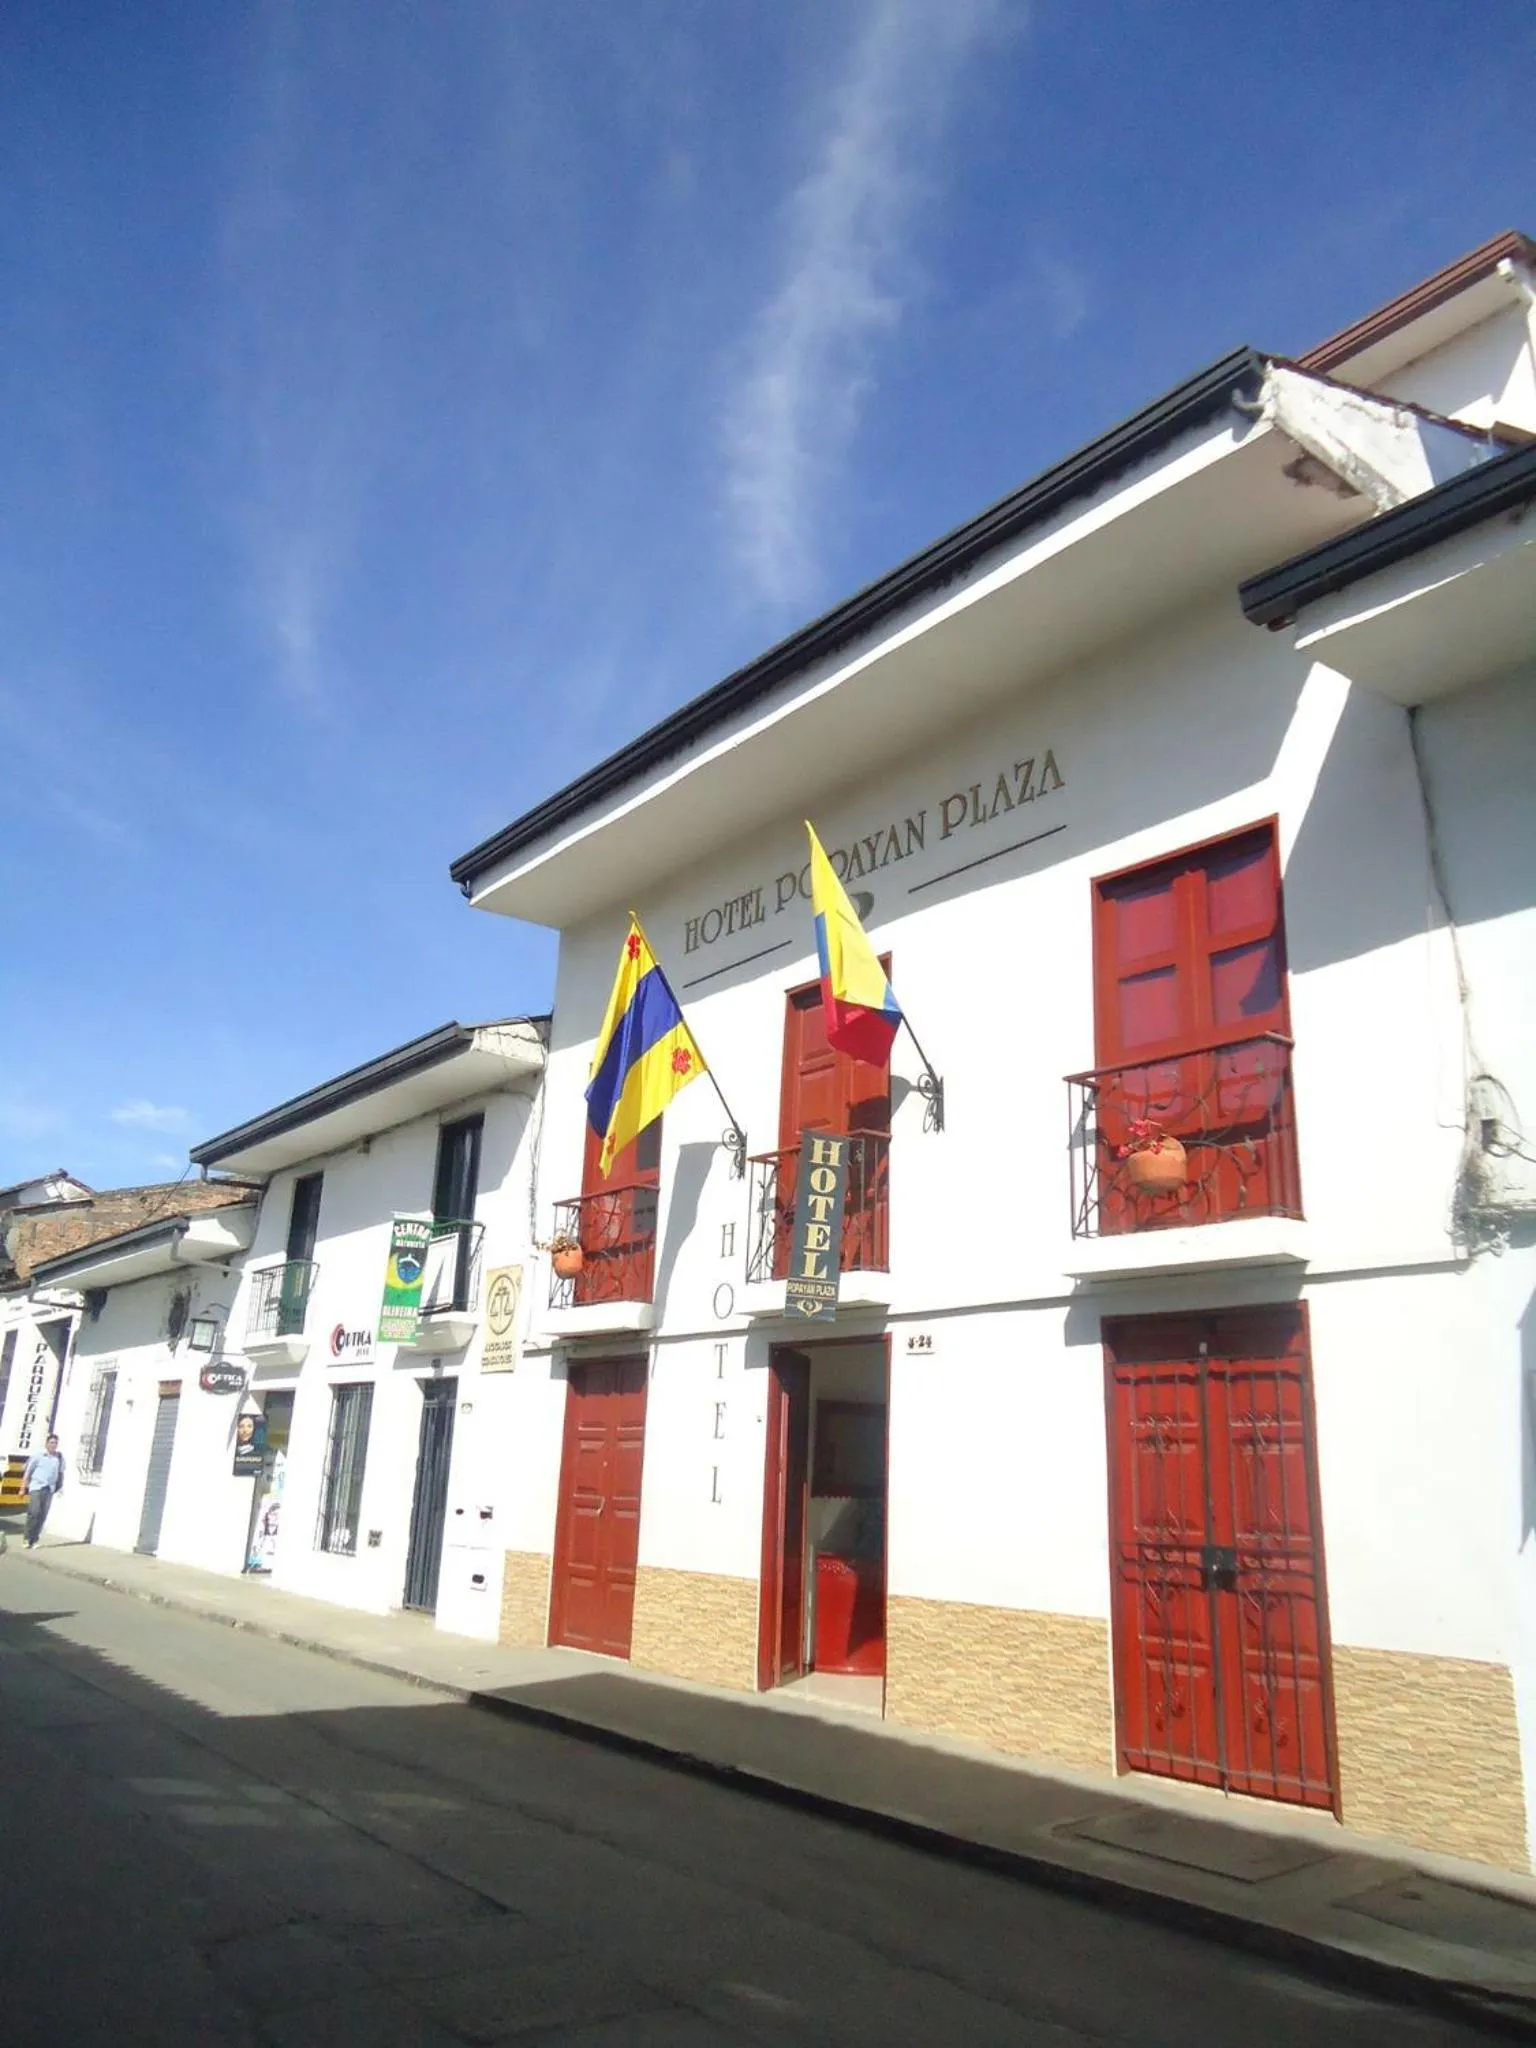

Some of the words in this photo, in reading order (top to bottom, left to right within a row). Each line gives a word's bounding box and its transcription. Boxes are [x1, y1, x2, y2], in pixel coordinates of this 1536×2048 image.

[684, 886, 765, 955] HOTEL
[939, 749, 1066, 841] PLAZA
[787, 1281, 815, 1295] POPAYAN
[815, 1284, 836, 1297] PLAZA
[801, 1138, 843, 1279] HOTEL
[711, 1222, 737, 1504] HOTEL
